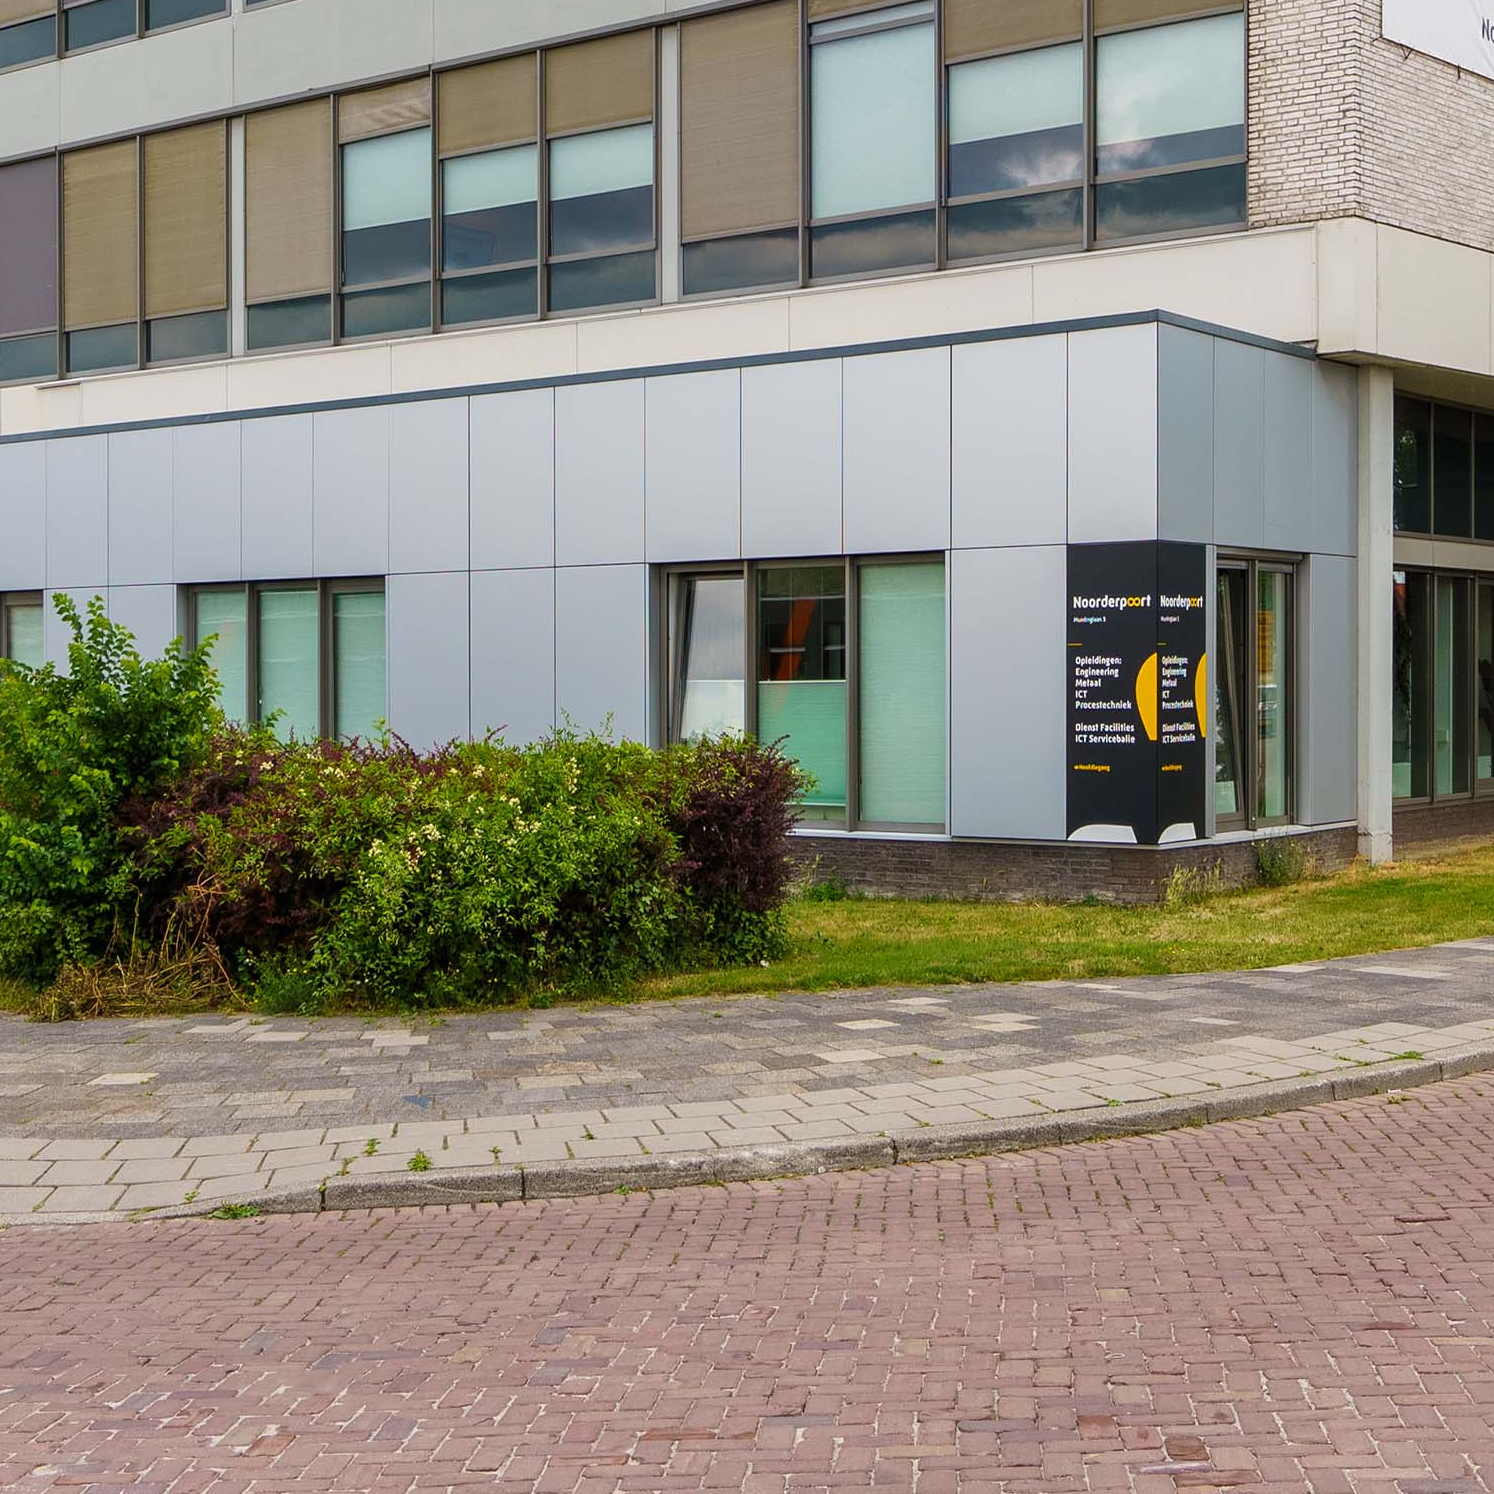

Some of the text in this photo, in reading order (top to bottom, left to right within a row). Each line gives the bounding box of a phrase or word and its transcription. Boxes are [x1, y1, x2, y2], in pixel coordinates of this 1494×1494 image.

[1072, 594, 1152, 611] Noorderpoort
[1160, 594, 1204, 611] Noorderpoort
[1075, 655, 1122, 667] Opleidingen:
[1075, 666, 1119, 678] Engineering
[1075, 678, 1101, 688] Metaal
[1075, 689, 1088, 699] ICT
[1075, 699, 1132, 709] Procestechniek
[1075, 722, 1135, 733] Dienst Facilities
[1075, 734, 1136, 744] ICT Servicebalie
